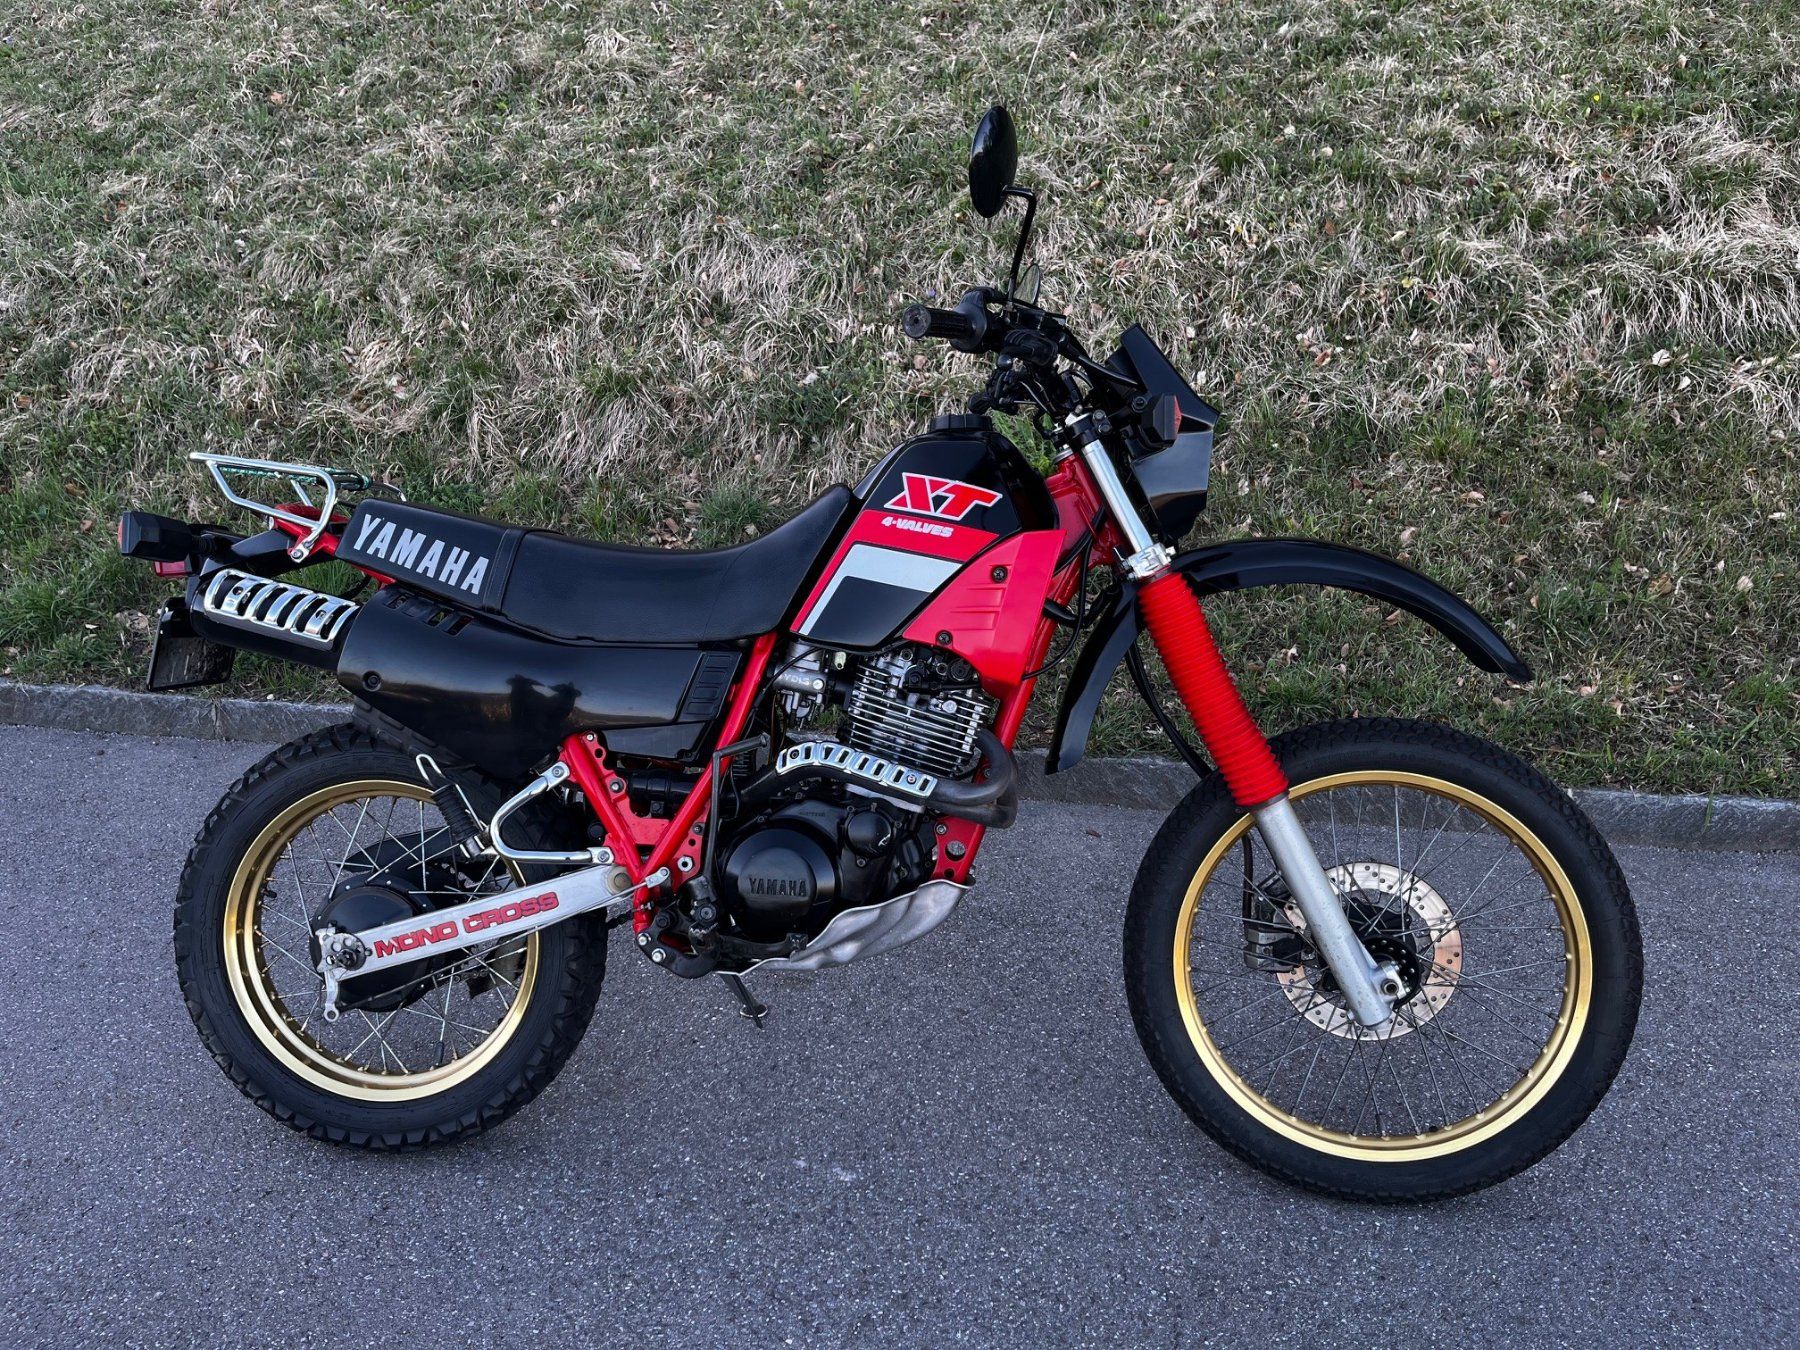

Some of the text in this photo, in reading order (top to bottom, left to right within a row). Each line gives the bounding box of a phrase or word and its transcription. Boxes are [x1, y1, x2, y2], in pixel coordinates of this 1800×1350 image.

[883, 472, 1003, 521] XT
[881, 516, 954, 538] 4-VALVES
[353, 513, 490, 595] YAMAHA
[749, 877, 807, 896] YAMAHA
[374, 891, 560, 958] MONO CROSS
